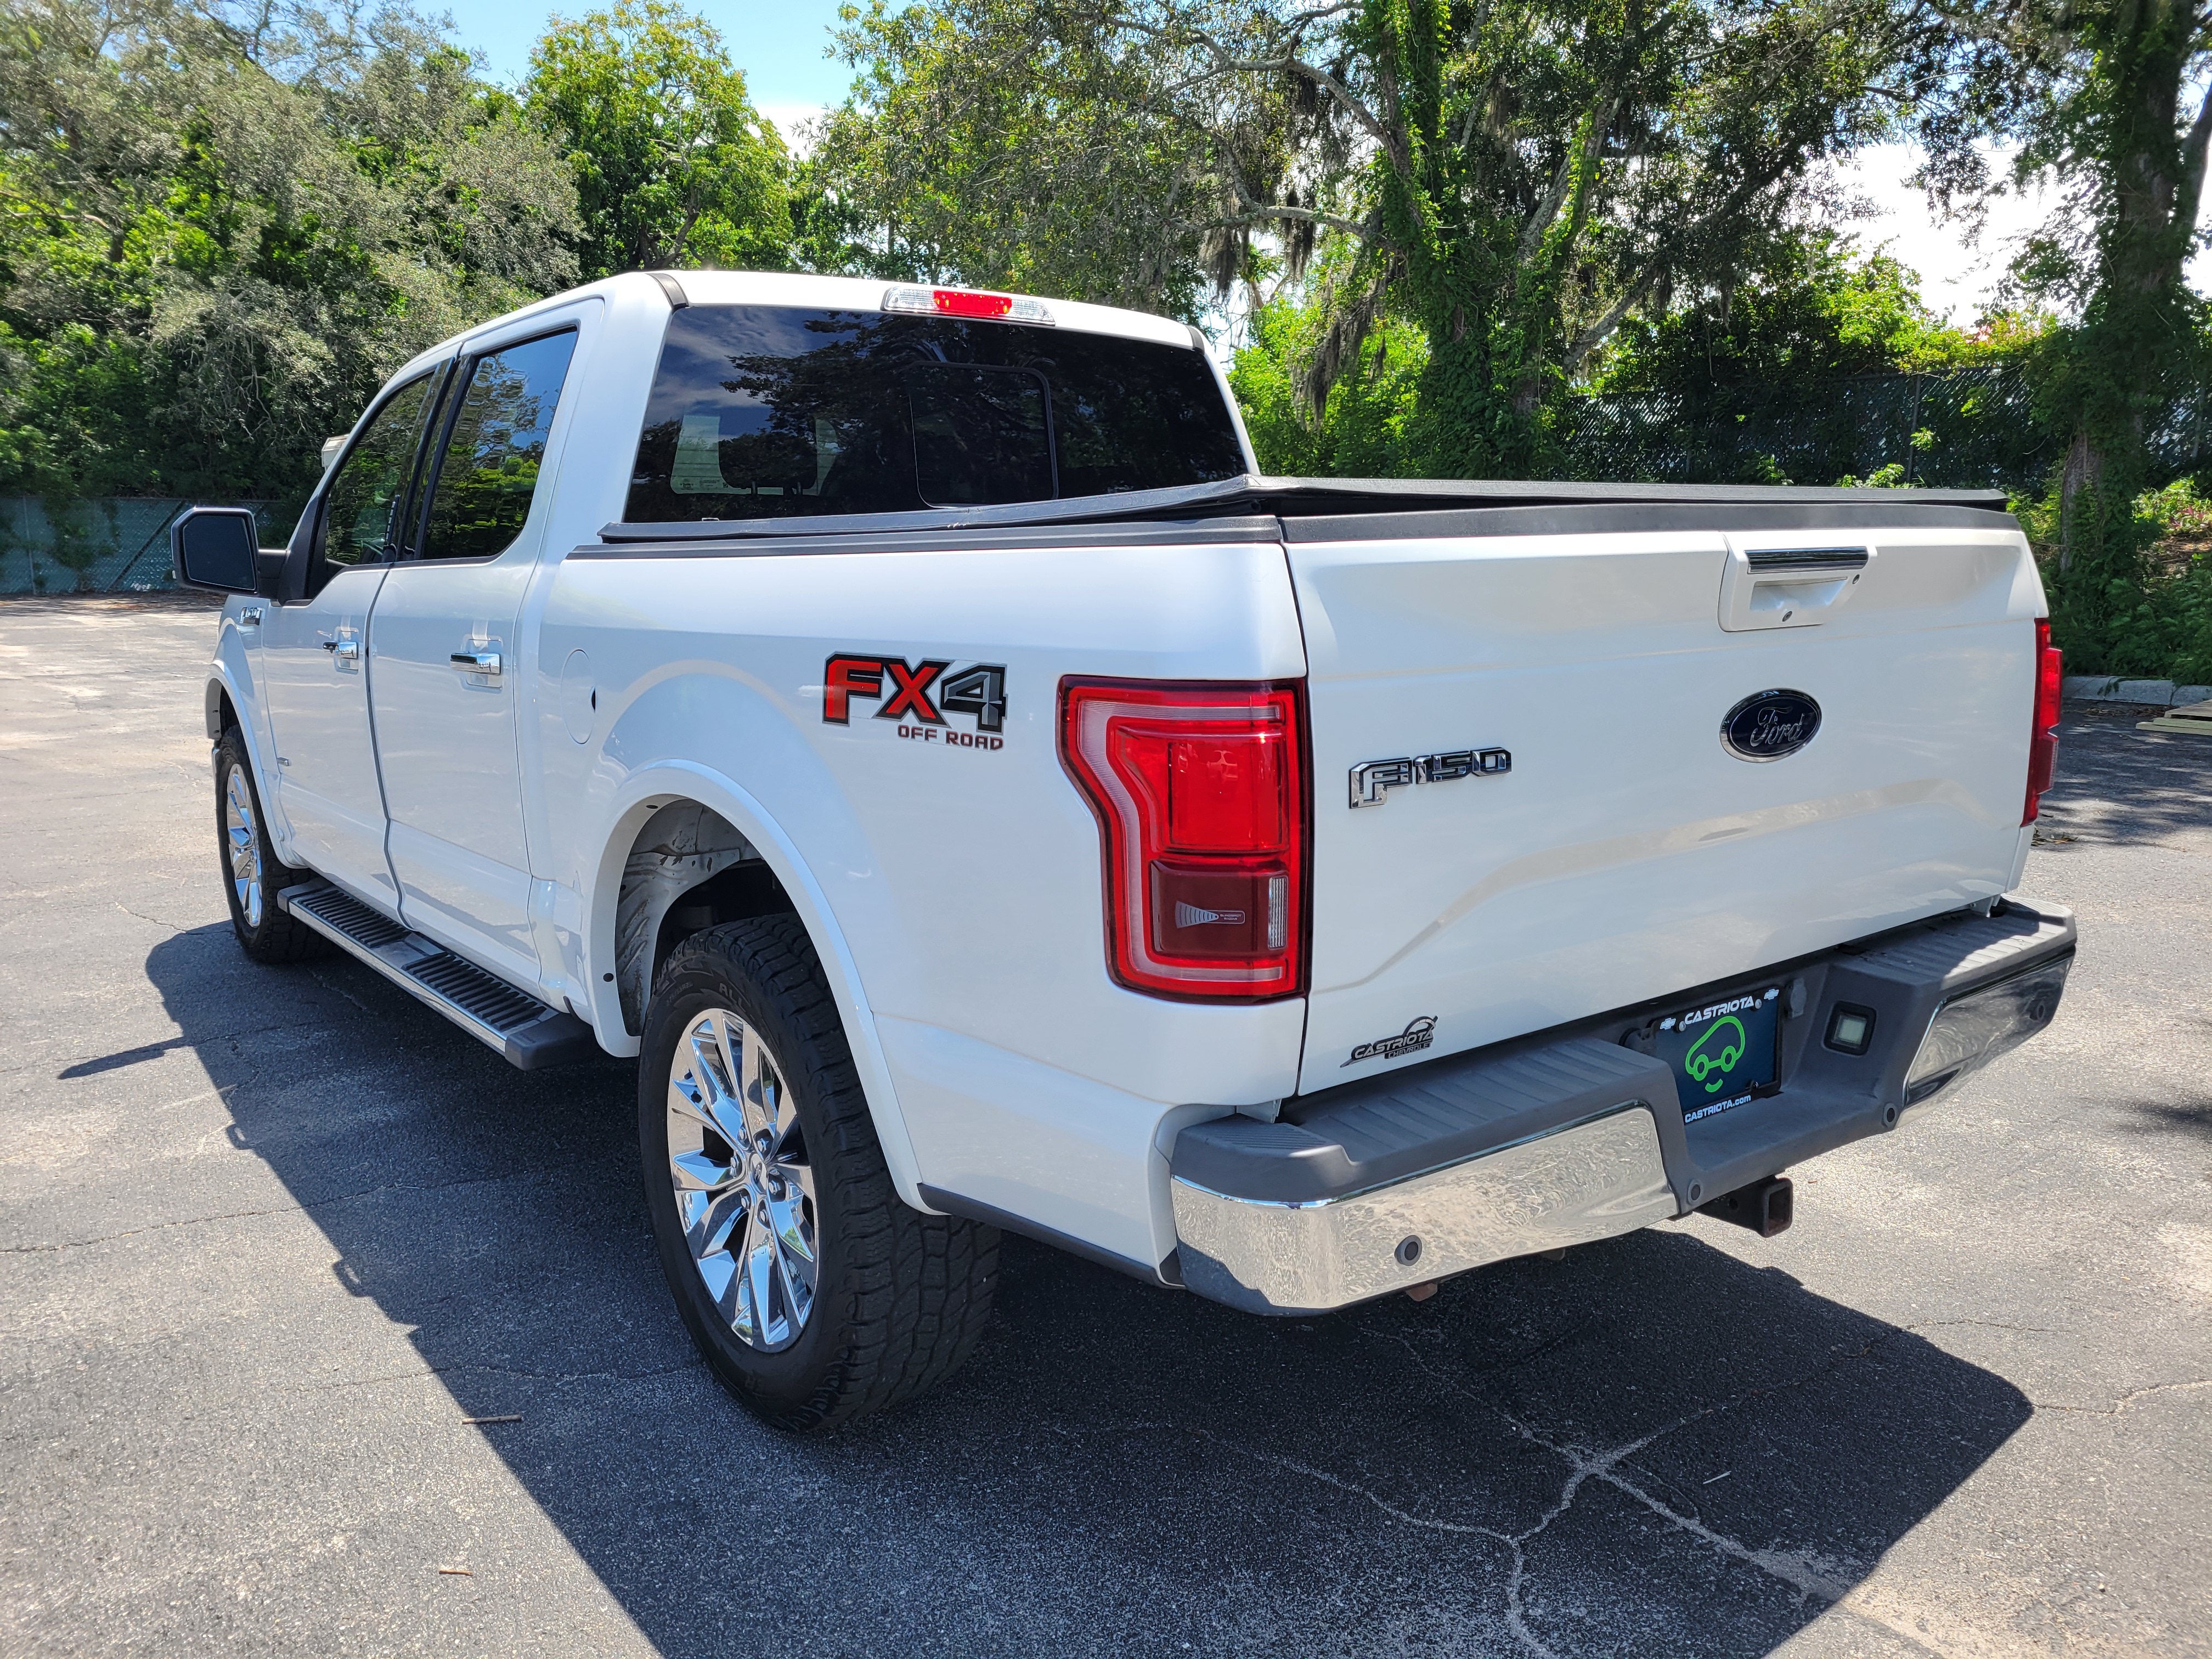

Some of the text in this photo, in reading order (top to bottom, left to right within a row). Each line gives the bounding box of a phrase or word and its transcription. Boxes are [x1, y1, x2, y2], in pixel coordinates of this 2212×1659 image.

[822, 651, 1008, 735] FX4
[898, 724, 1003, 751] OFF ROAD
[1750, 707, 1805, 747] Ford
[1684, 995, 1755, 1025] CASTRIOTA
[1354, 1029, 1434, 1059] CASTRIOTA
[1388, 1042, 1431, 1059] CHEVROLET
[1685, 1094, 1751, 1124] CASTRIOTA.com
